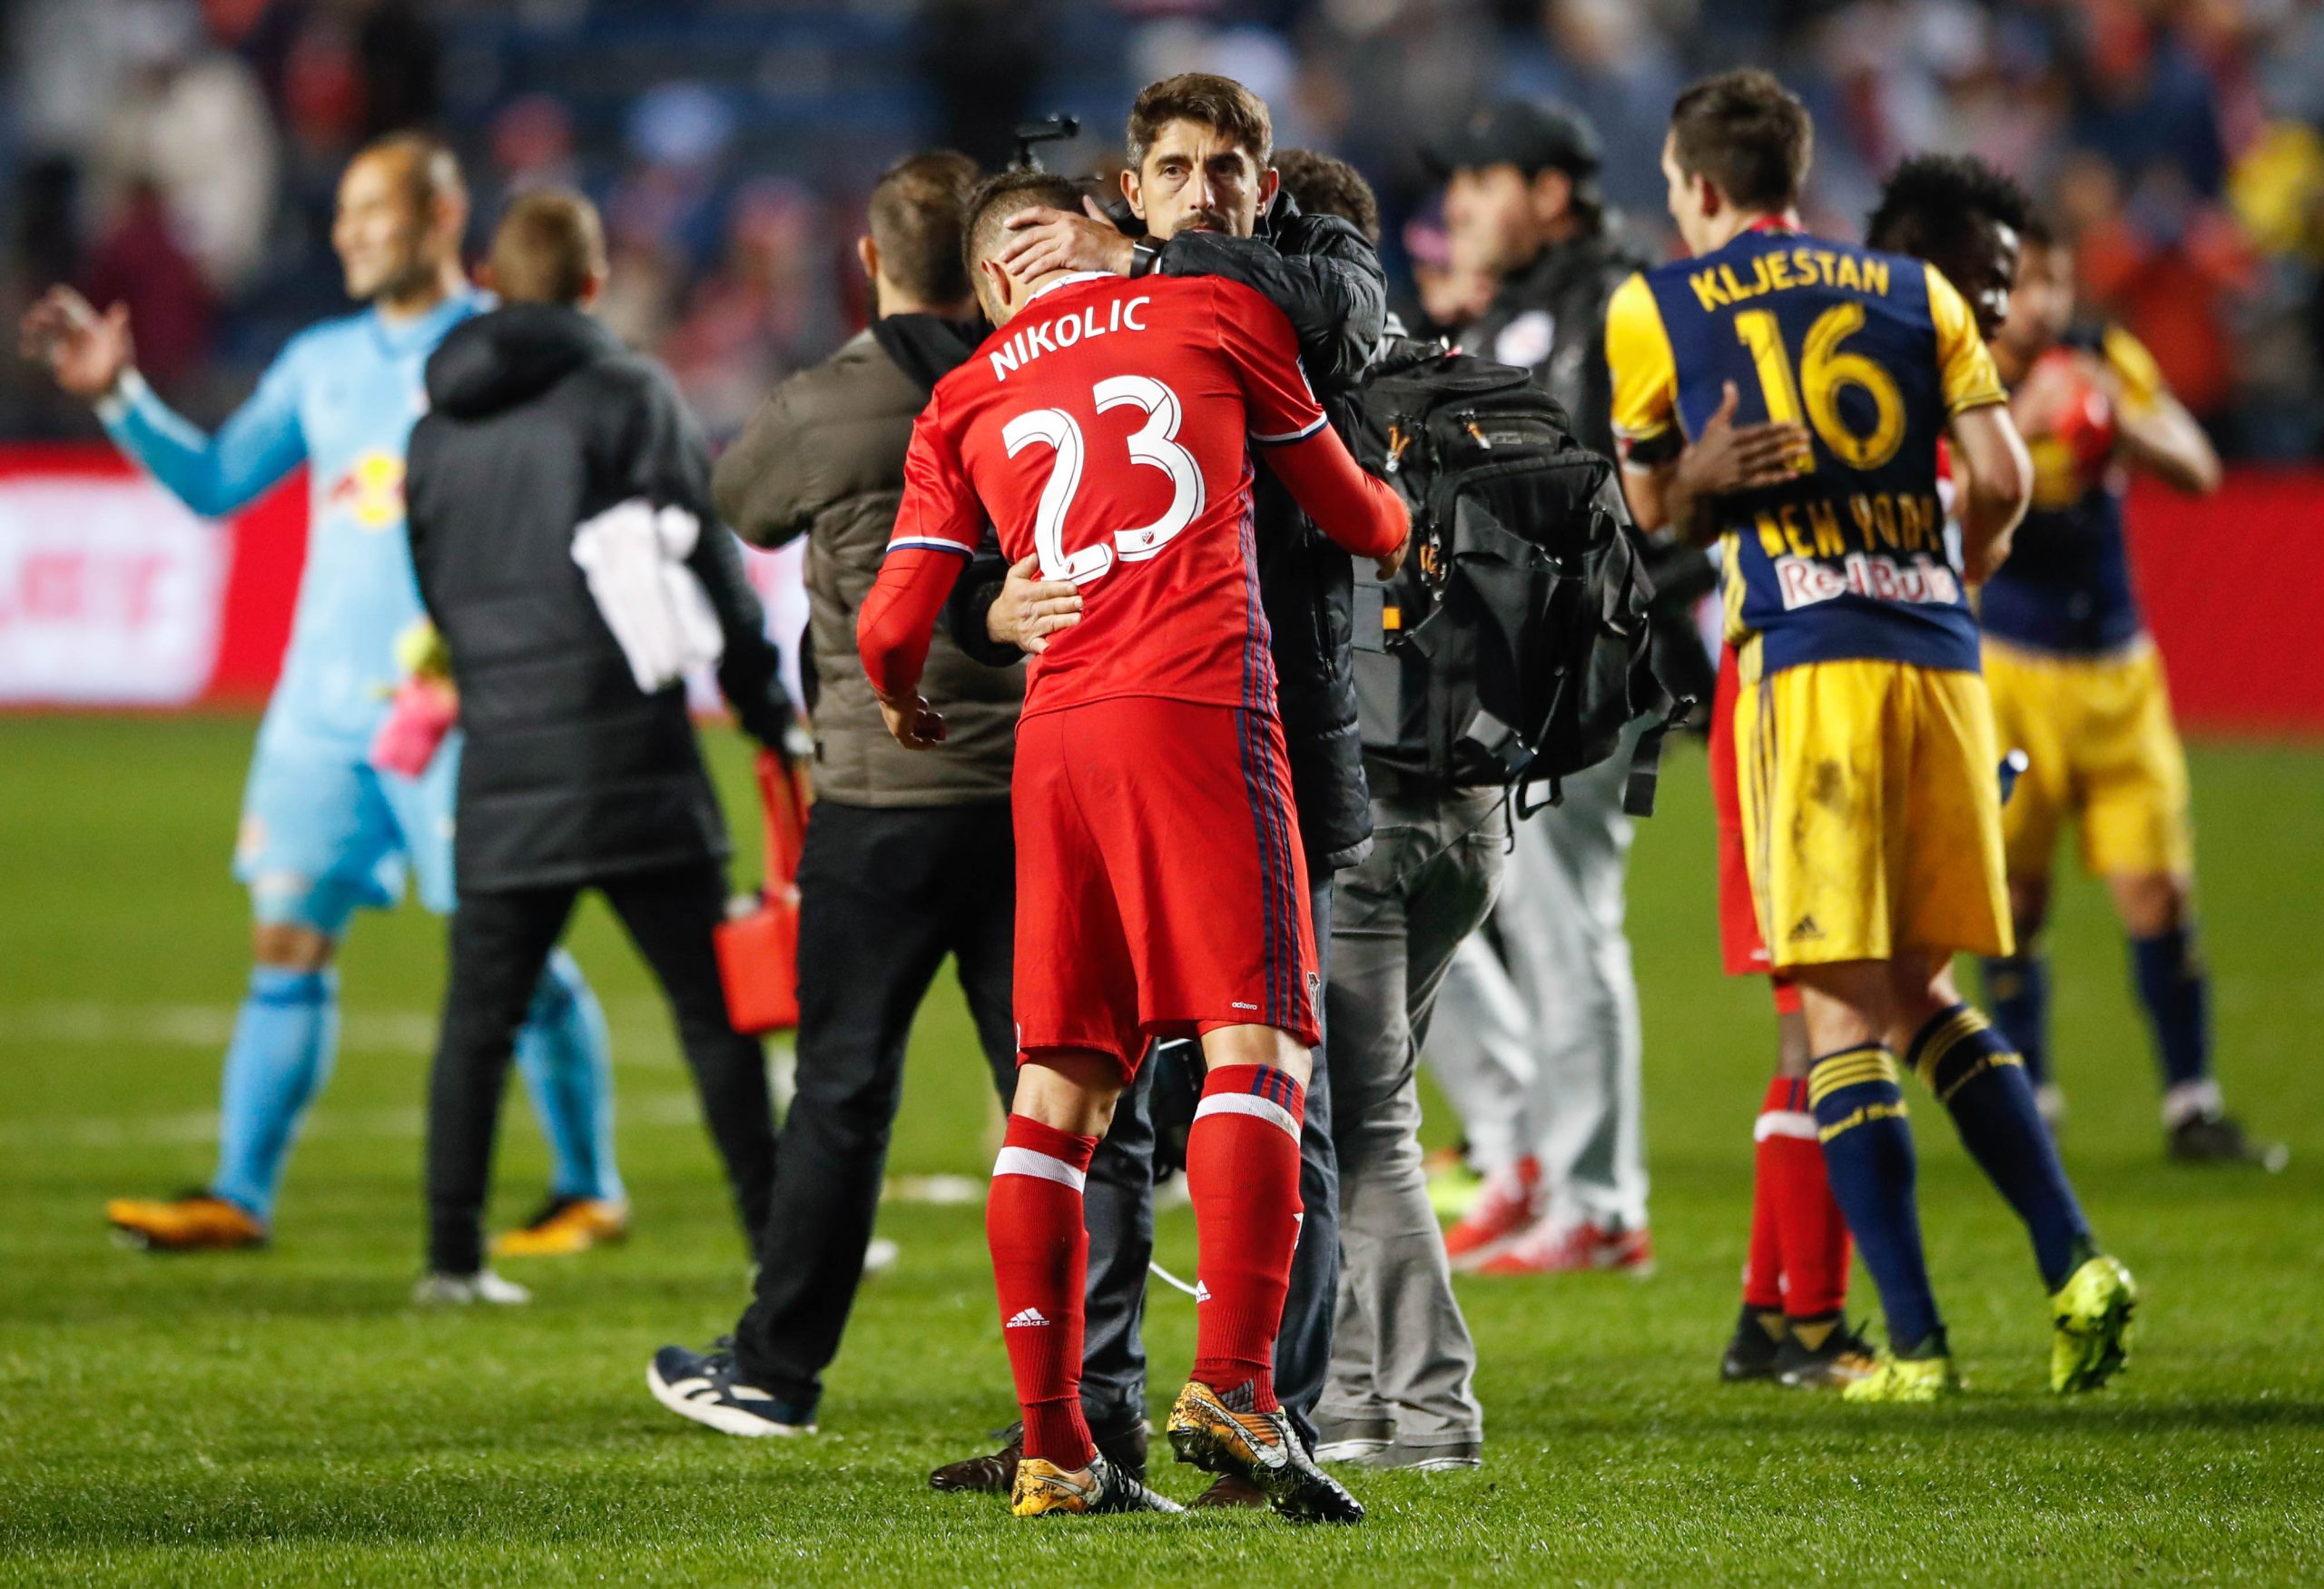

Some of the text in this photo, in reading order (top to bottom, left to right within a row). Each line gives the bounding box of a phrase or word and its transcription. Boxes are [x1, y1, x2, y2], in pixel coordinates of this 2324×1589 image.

[990, 296, 1150, 382] NIKOLIC
[1689, 249, 1889, 312] KLJESTAN
[1734, 301, 1905, 474] 16
[1001, 374, 1206, 586] 23
